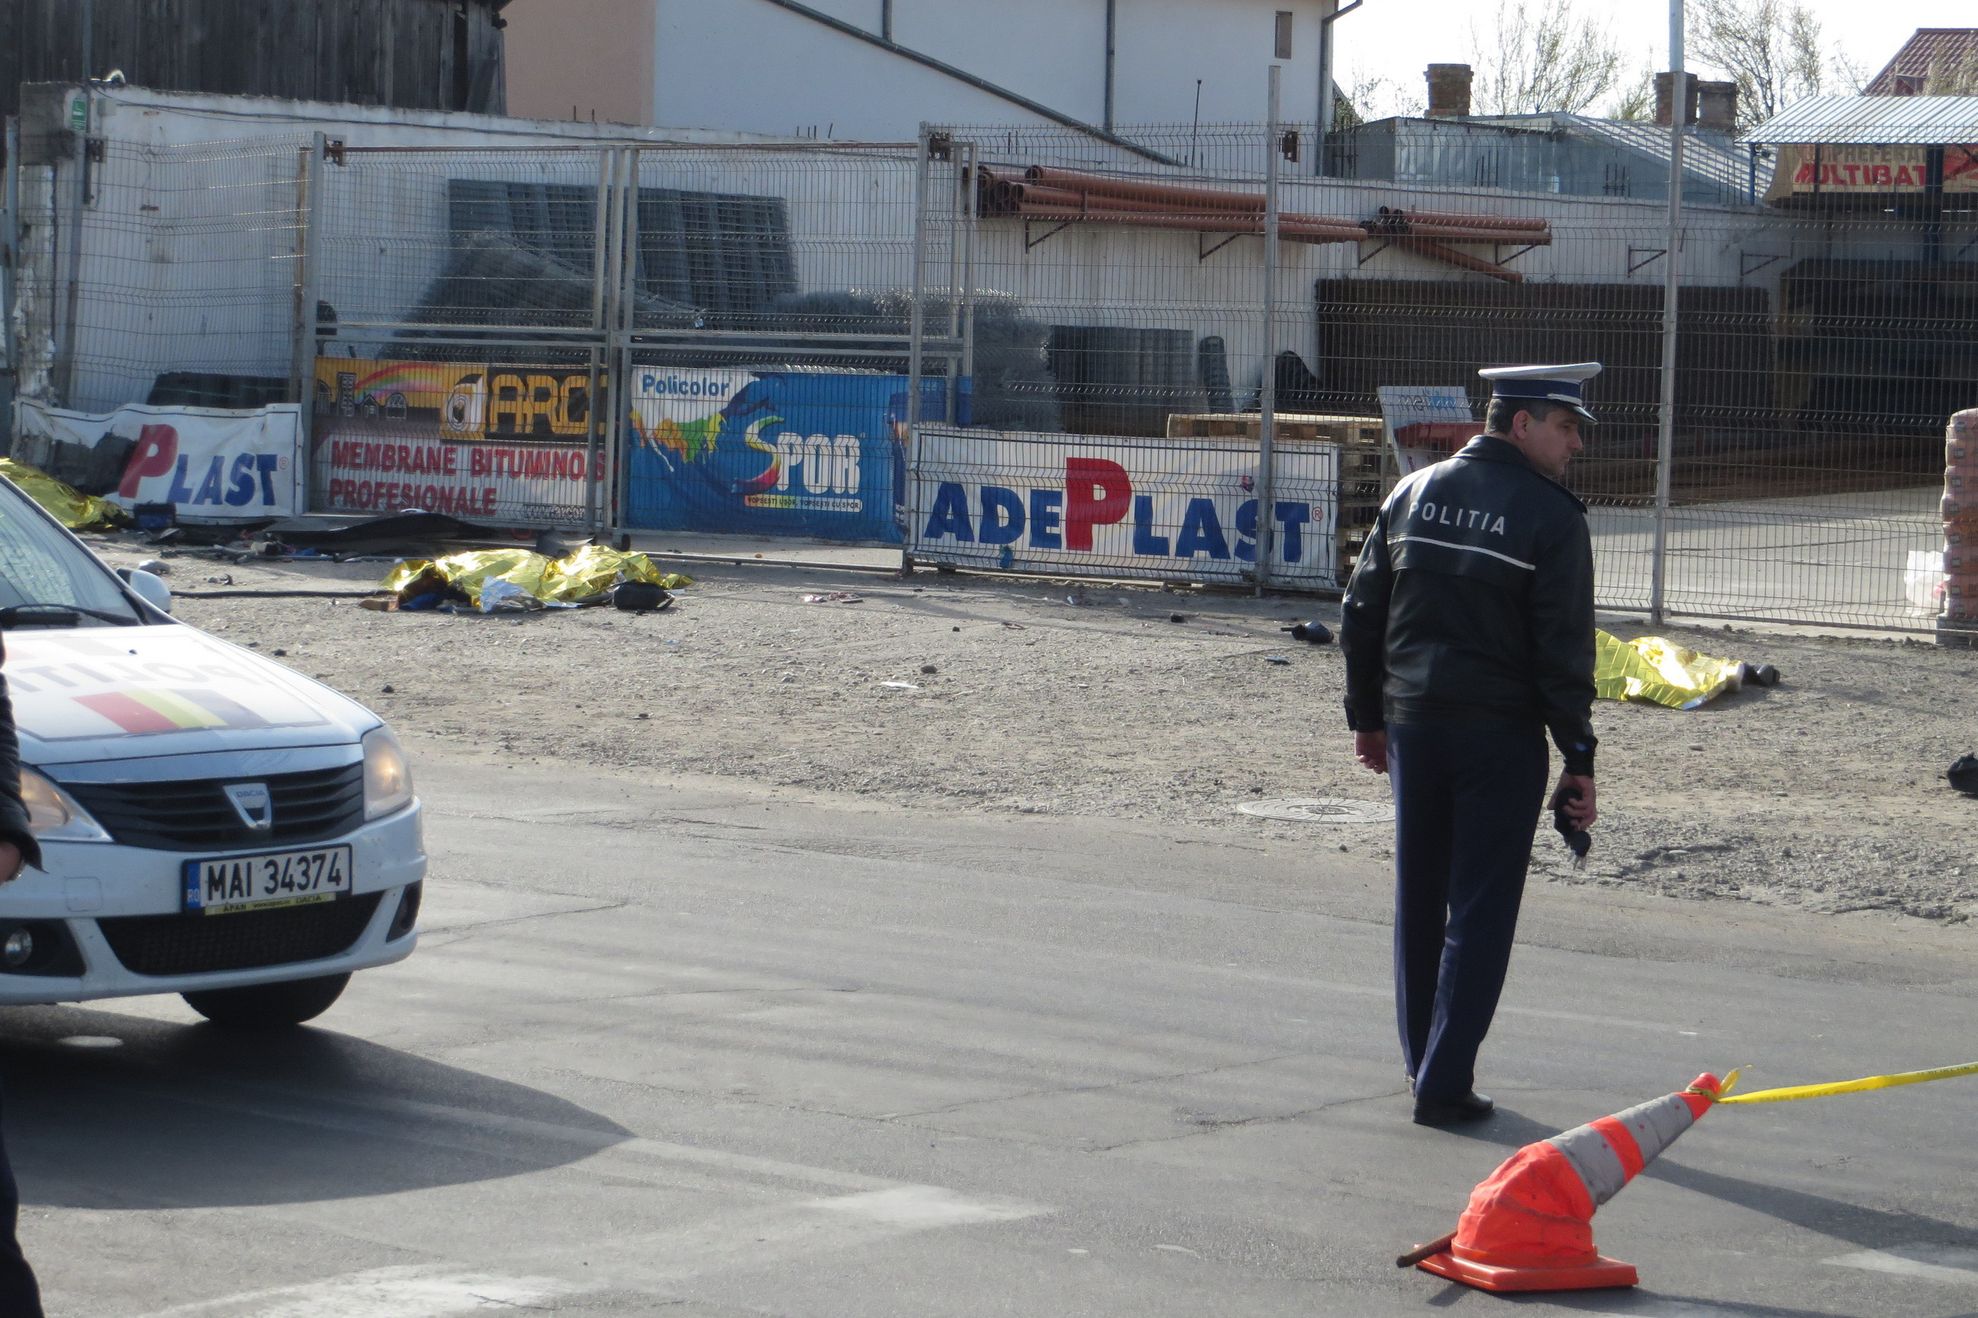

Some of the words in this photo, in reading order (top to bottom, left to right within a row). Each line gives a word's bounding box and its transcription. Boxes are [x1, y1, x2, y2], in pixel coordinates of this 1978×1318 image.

[490, 374, 609, 435] ARC
[642, 375, 729, 397] Policolor
[331, 440, 458, 477] MEMBRANE
[329, 478, 497, 515] PROFESIONALE
[923, 456, 1311, 563] ADEPLAST
[1408, 502, 1506, 535] POLITIA
[208, 861, 252, 901] MAI
[264, 852, 342, 895] 34374
